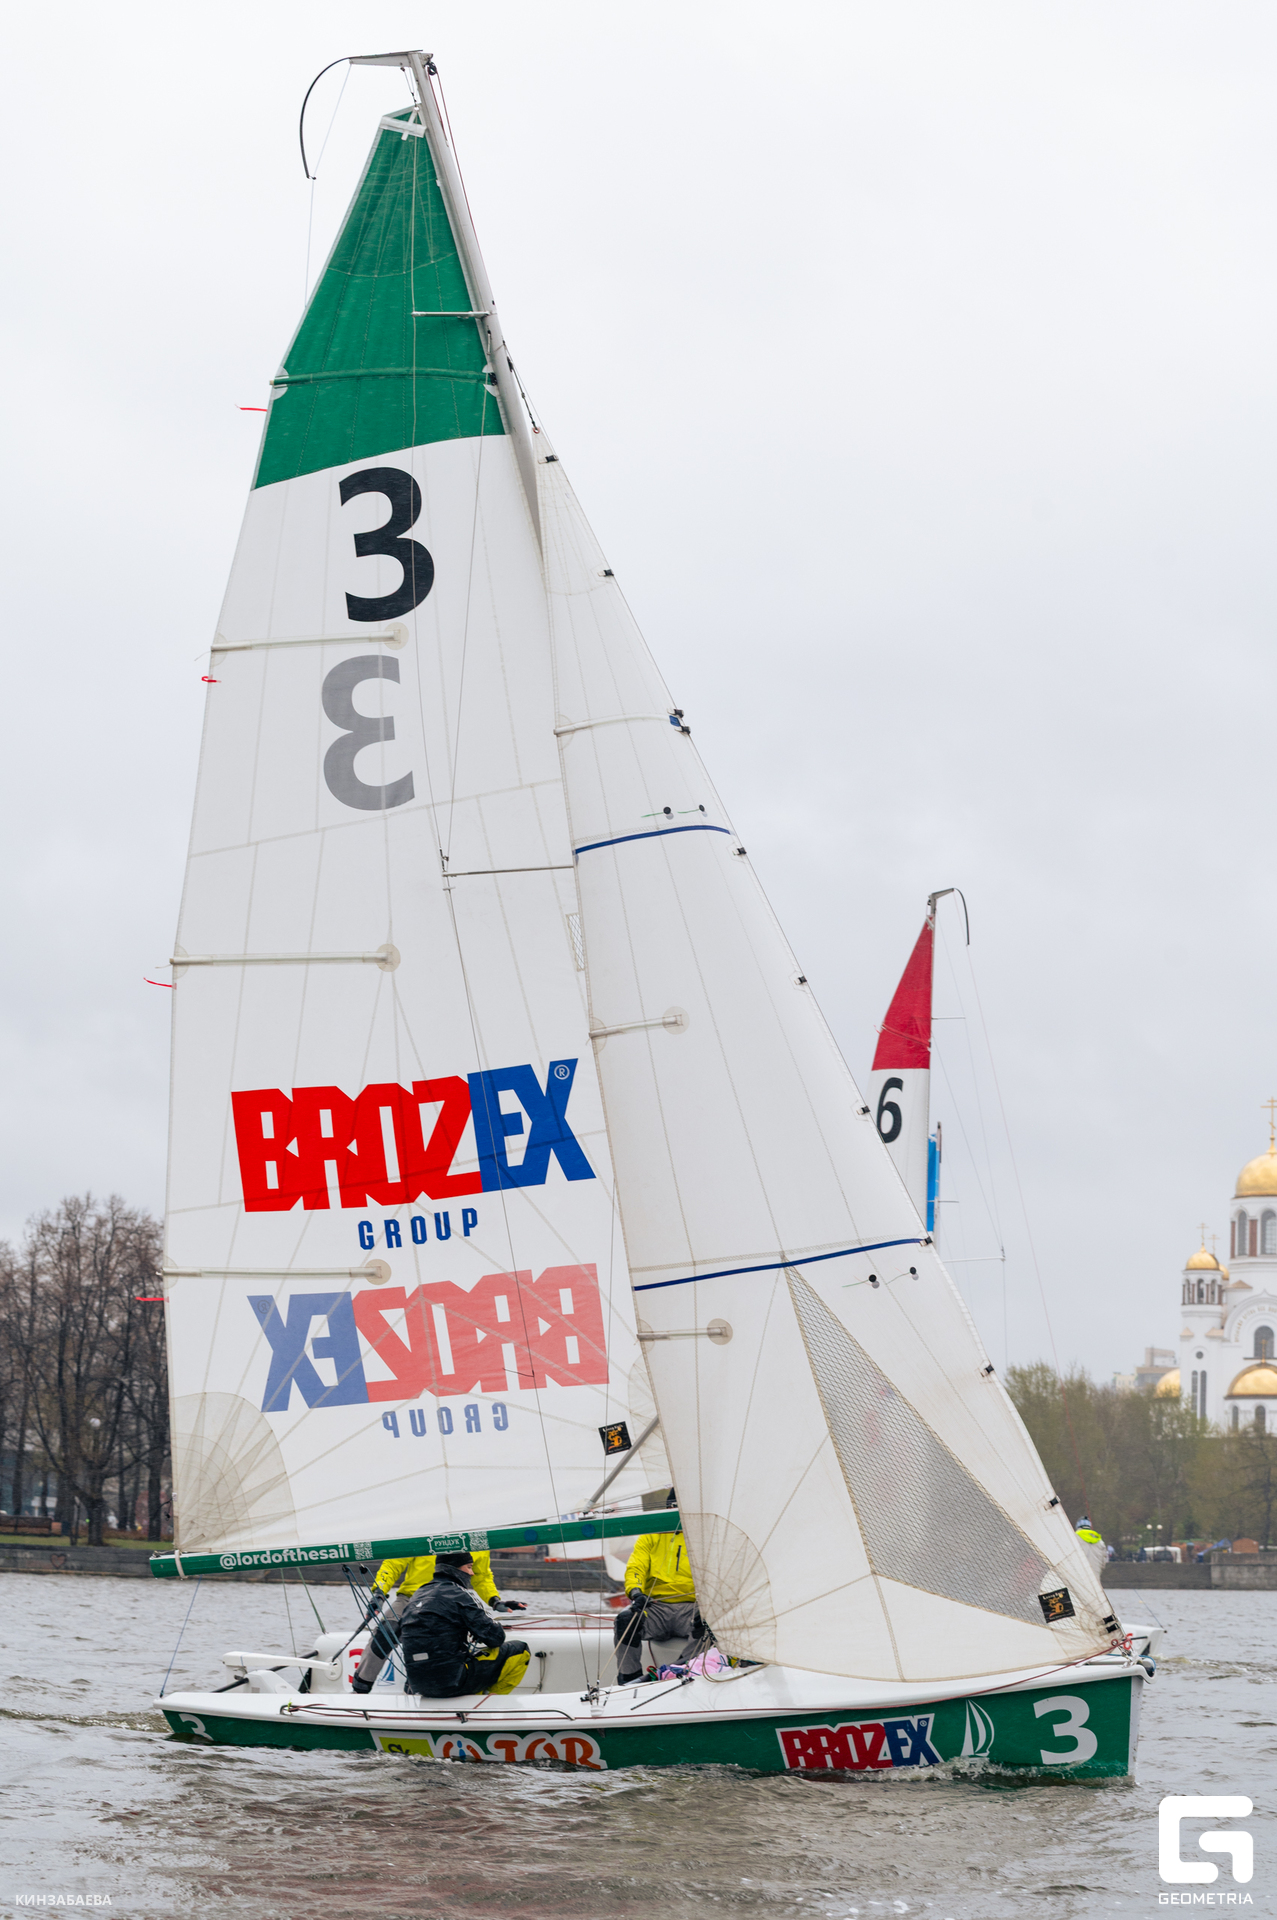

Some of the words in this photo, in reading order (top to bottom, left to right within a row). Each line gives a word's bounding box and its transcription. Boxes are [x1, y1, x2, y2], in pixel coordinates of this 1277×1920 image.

[339, 467, 435, 622] 3
[876, 1077, 904, 1143] 6
[357, 1207, 478, 1250] GROUP
[219, 1544, 350, 1570] @lordofthesail
[1033, 1695, 1098, 1765] 3
